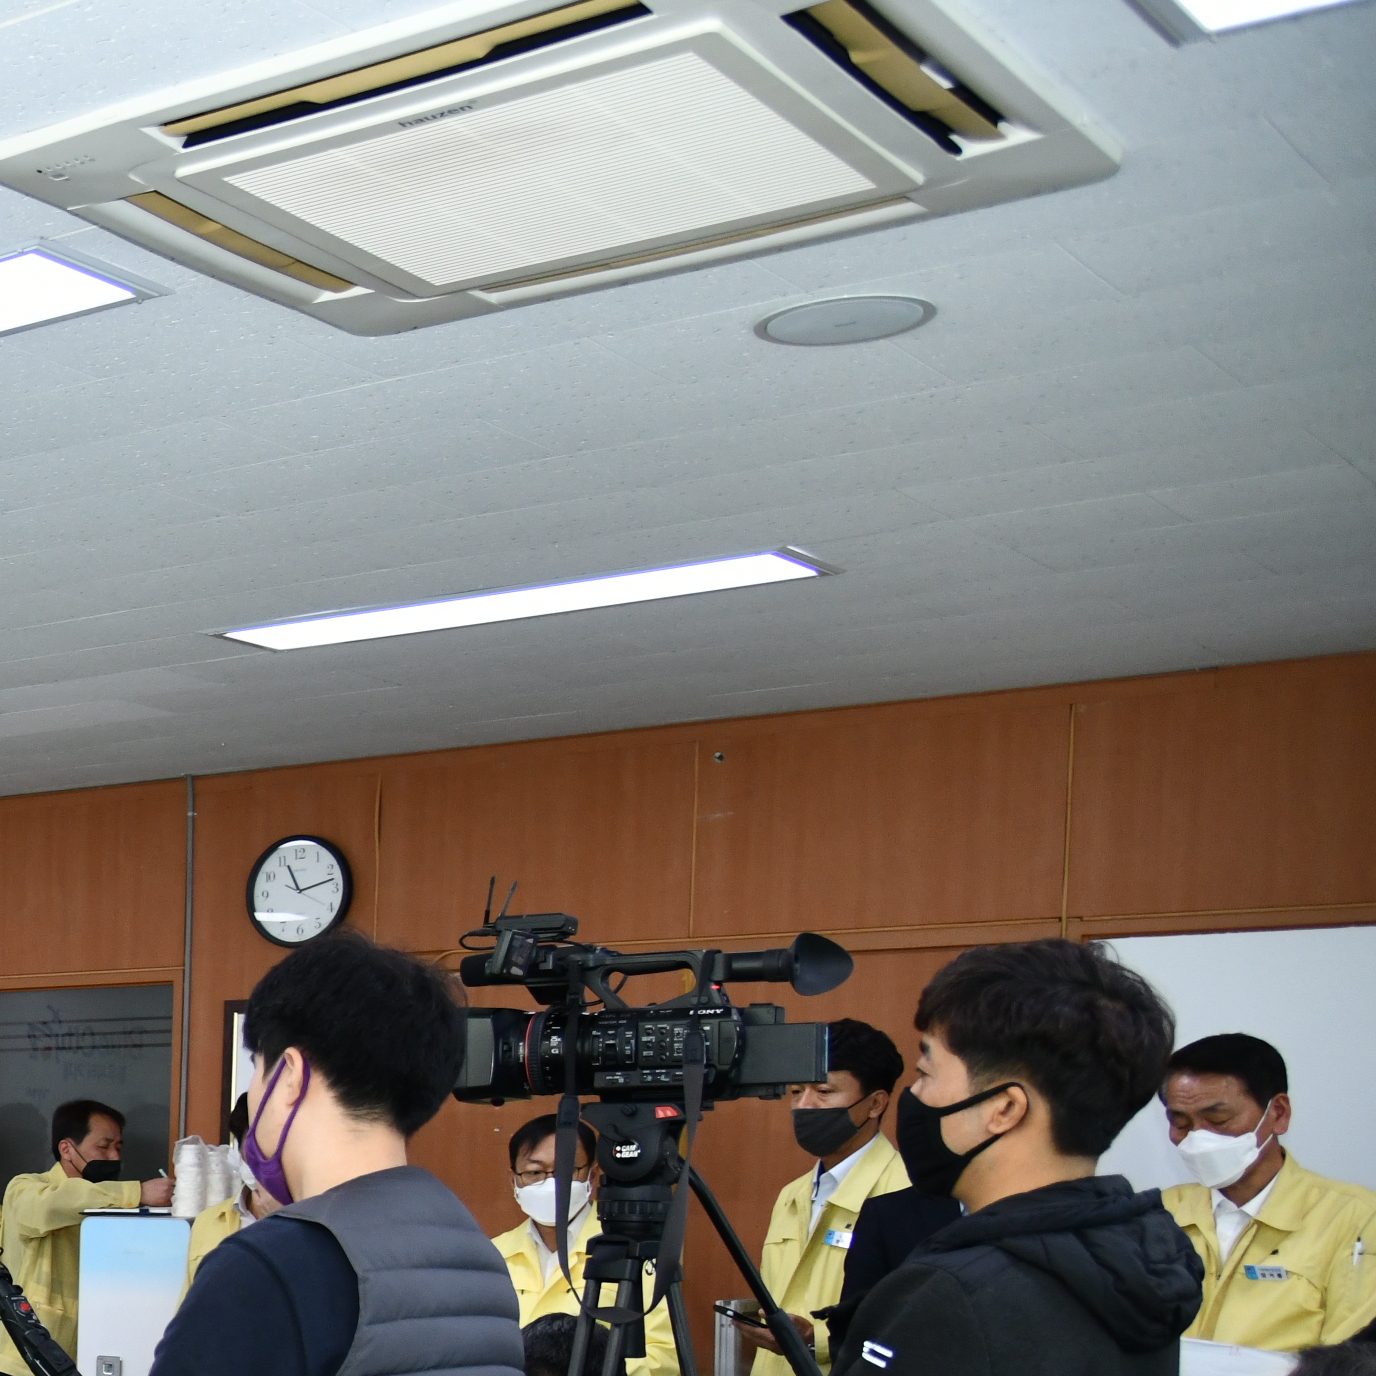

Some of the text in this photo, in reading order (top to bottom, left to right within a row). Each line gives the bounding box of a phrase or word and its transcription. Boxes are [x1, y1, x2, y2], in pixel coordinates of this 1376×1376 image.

[397, 104, 474, 128] hauzen
[294, 848, 306, 860] 12
[278, 855, 287, 868] 11
[327, 864, 334, 876] 2
[265, 871, 276, 883] 10
[331, 882, 339, 894] 3
[261, 890, 269, 901] 9
[327, 902, 335, 913] 4
[279, 921, 287, 933] 7
[314, 917, 322, 929] 5
[296, 923, 304, 936] 6
[621, 1144, 637, 1152] CAM
